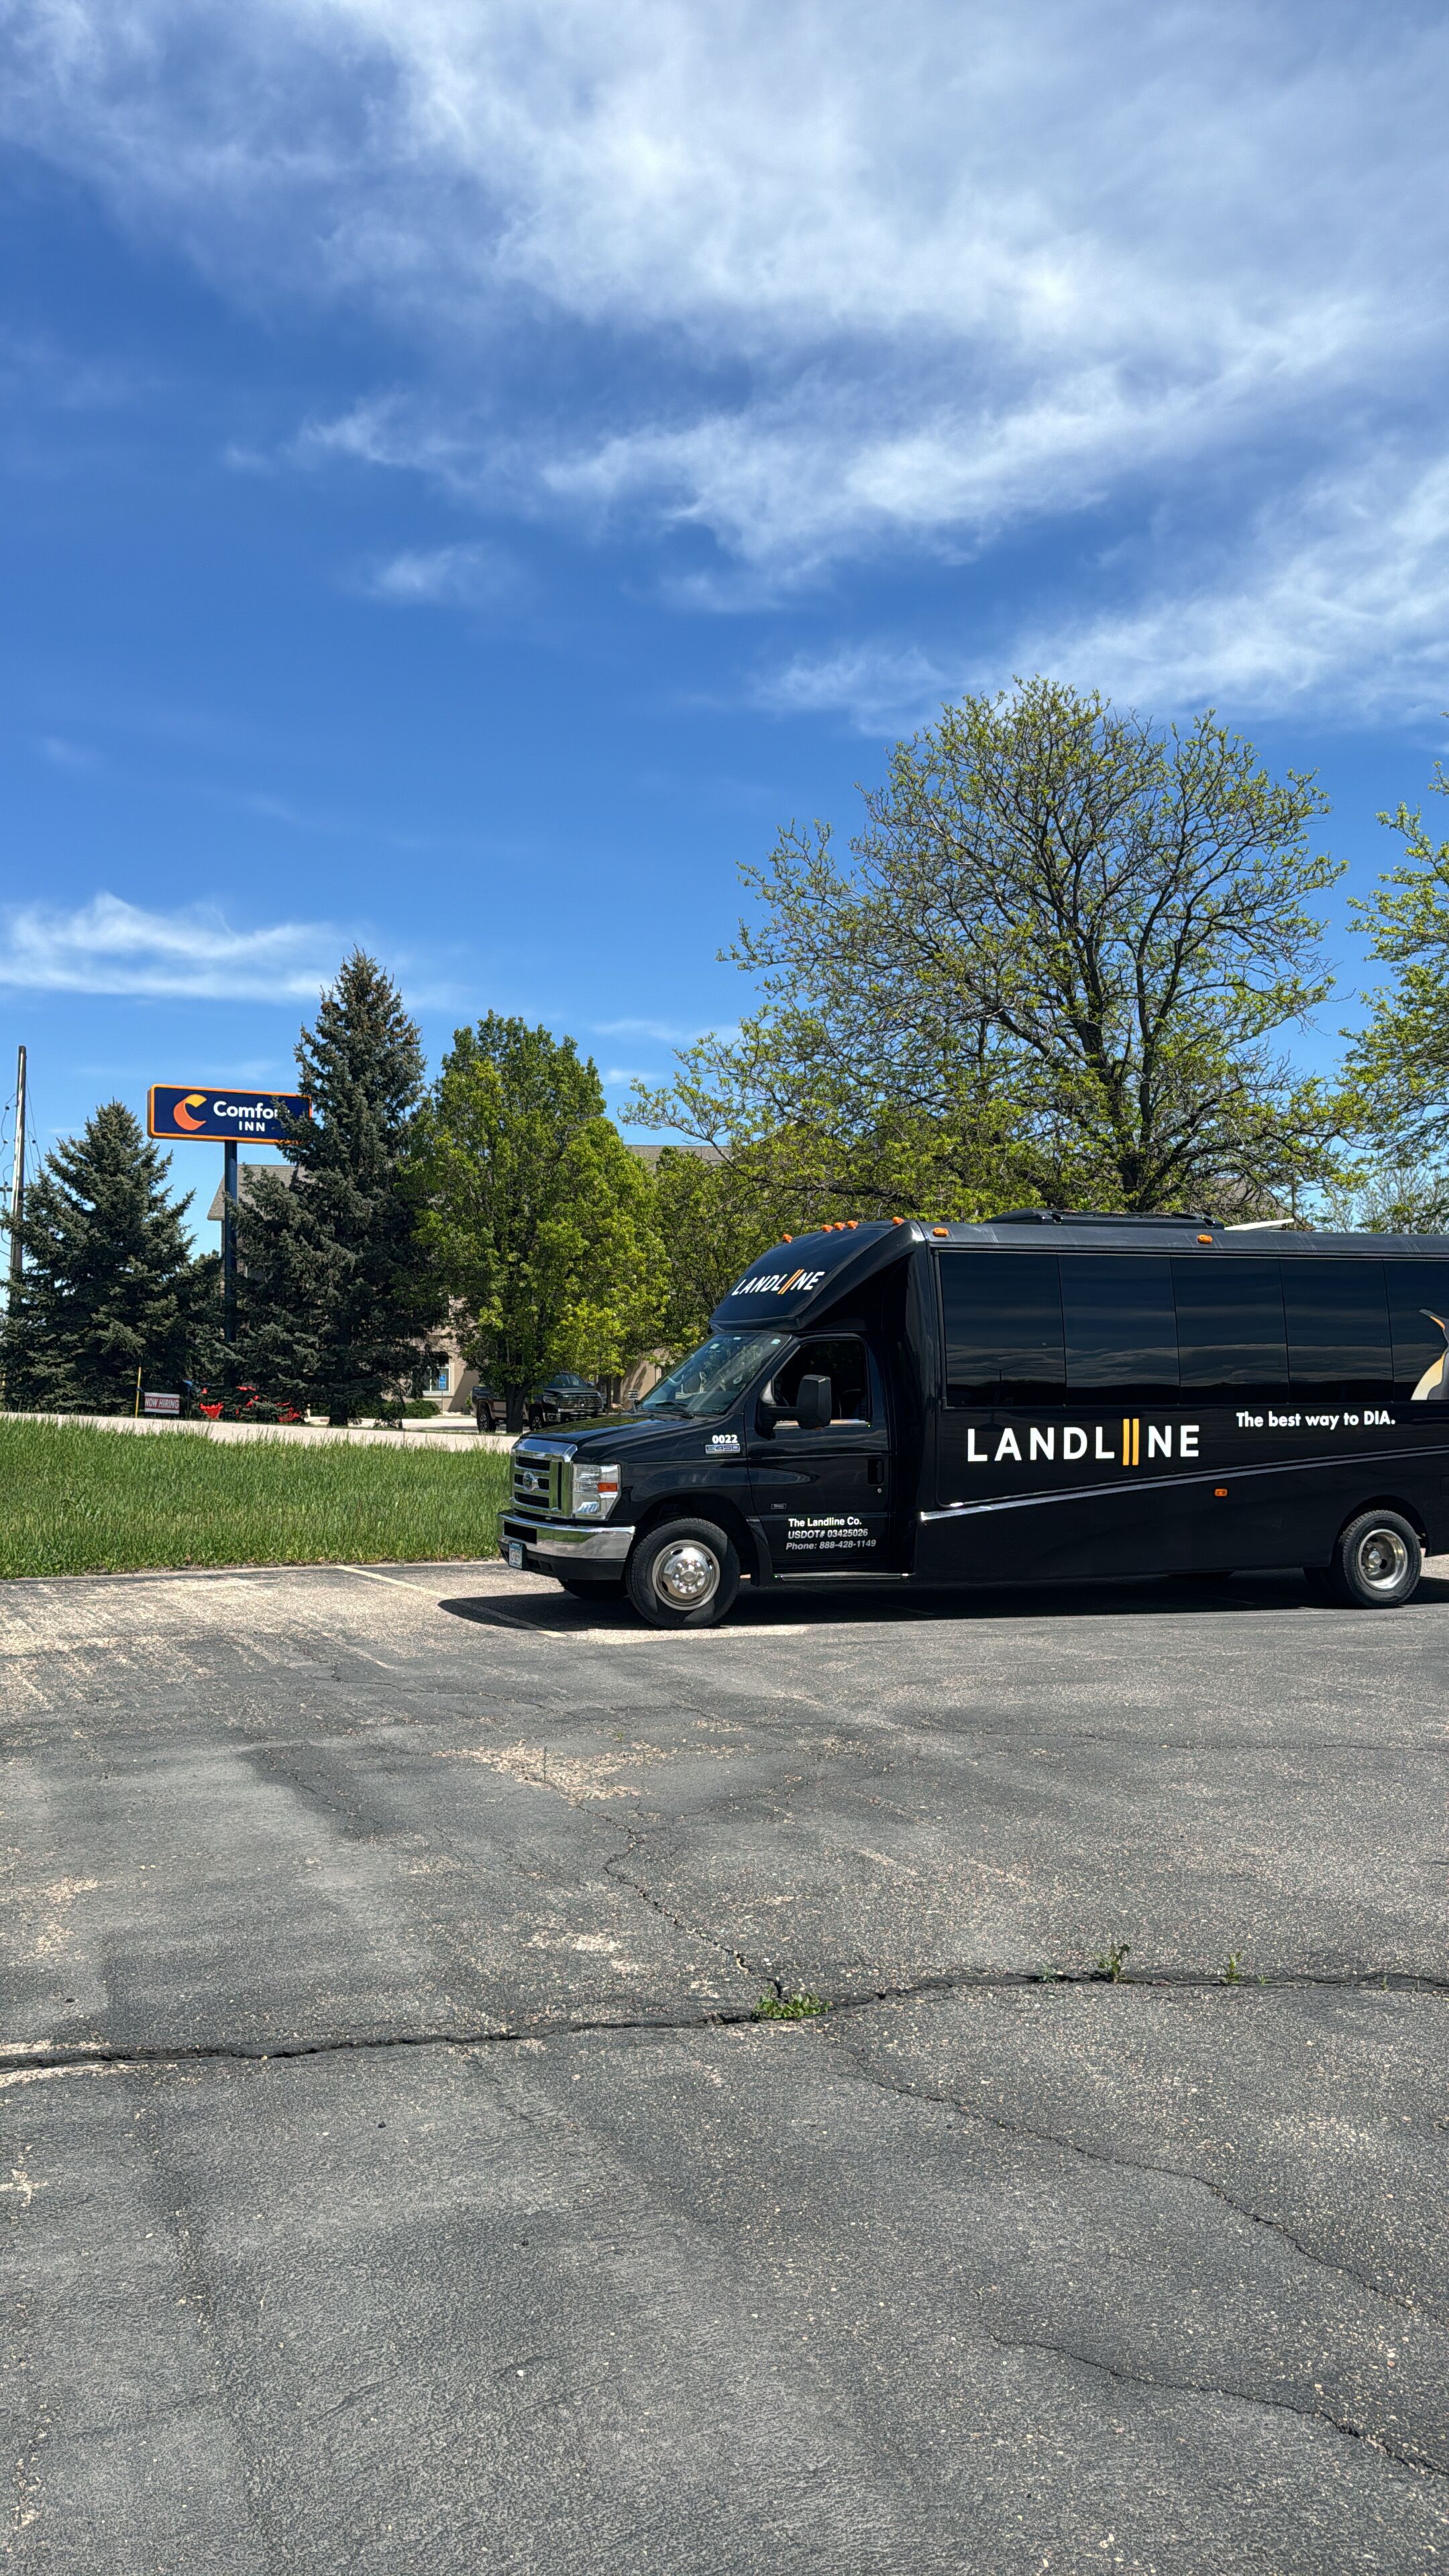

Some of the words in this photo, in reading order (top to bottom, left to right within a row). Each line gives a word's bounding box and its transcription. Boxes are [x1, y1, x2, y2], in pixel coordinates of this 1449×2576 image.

[239, 1121, 265, 1132] INN
[145, 1397, 158, 1407] NOW
[158, 1398, 180, 1409] HIRING
[1236, 1411, 1263, 1427] The
[1269, 1411, 1301, 1427] best
[1305, 1415, 1339, 1430] way
[1344, 1413, 1358, 1425] to
[1364, 1411, 1395, 1426] DIA.
[712, 1434, 738, 1444] 0022
[788, 1518, 805, 1527] The
[807, 1517, 845, 1527] Landline
[847, 1516, 862, 1525] Co.
[788, 1530, 825, 1539] USDOT#
[827, 1528, 869, 1538] 03425026
[786, 1542, 818, 1550] Phone:
[819, 1539, 877, 1549] 888-428-1149
